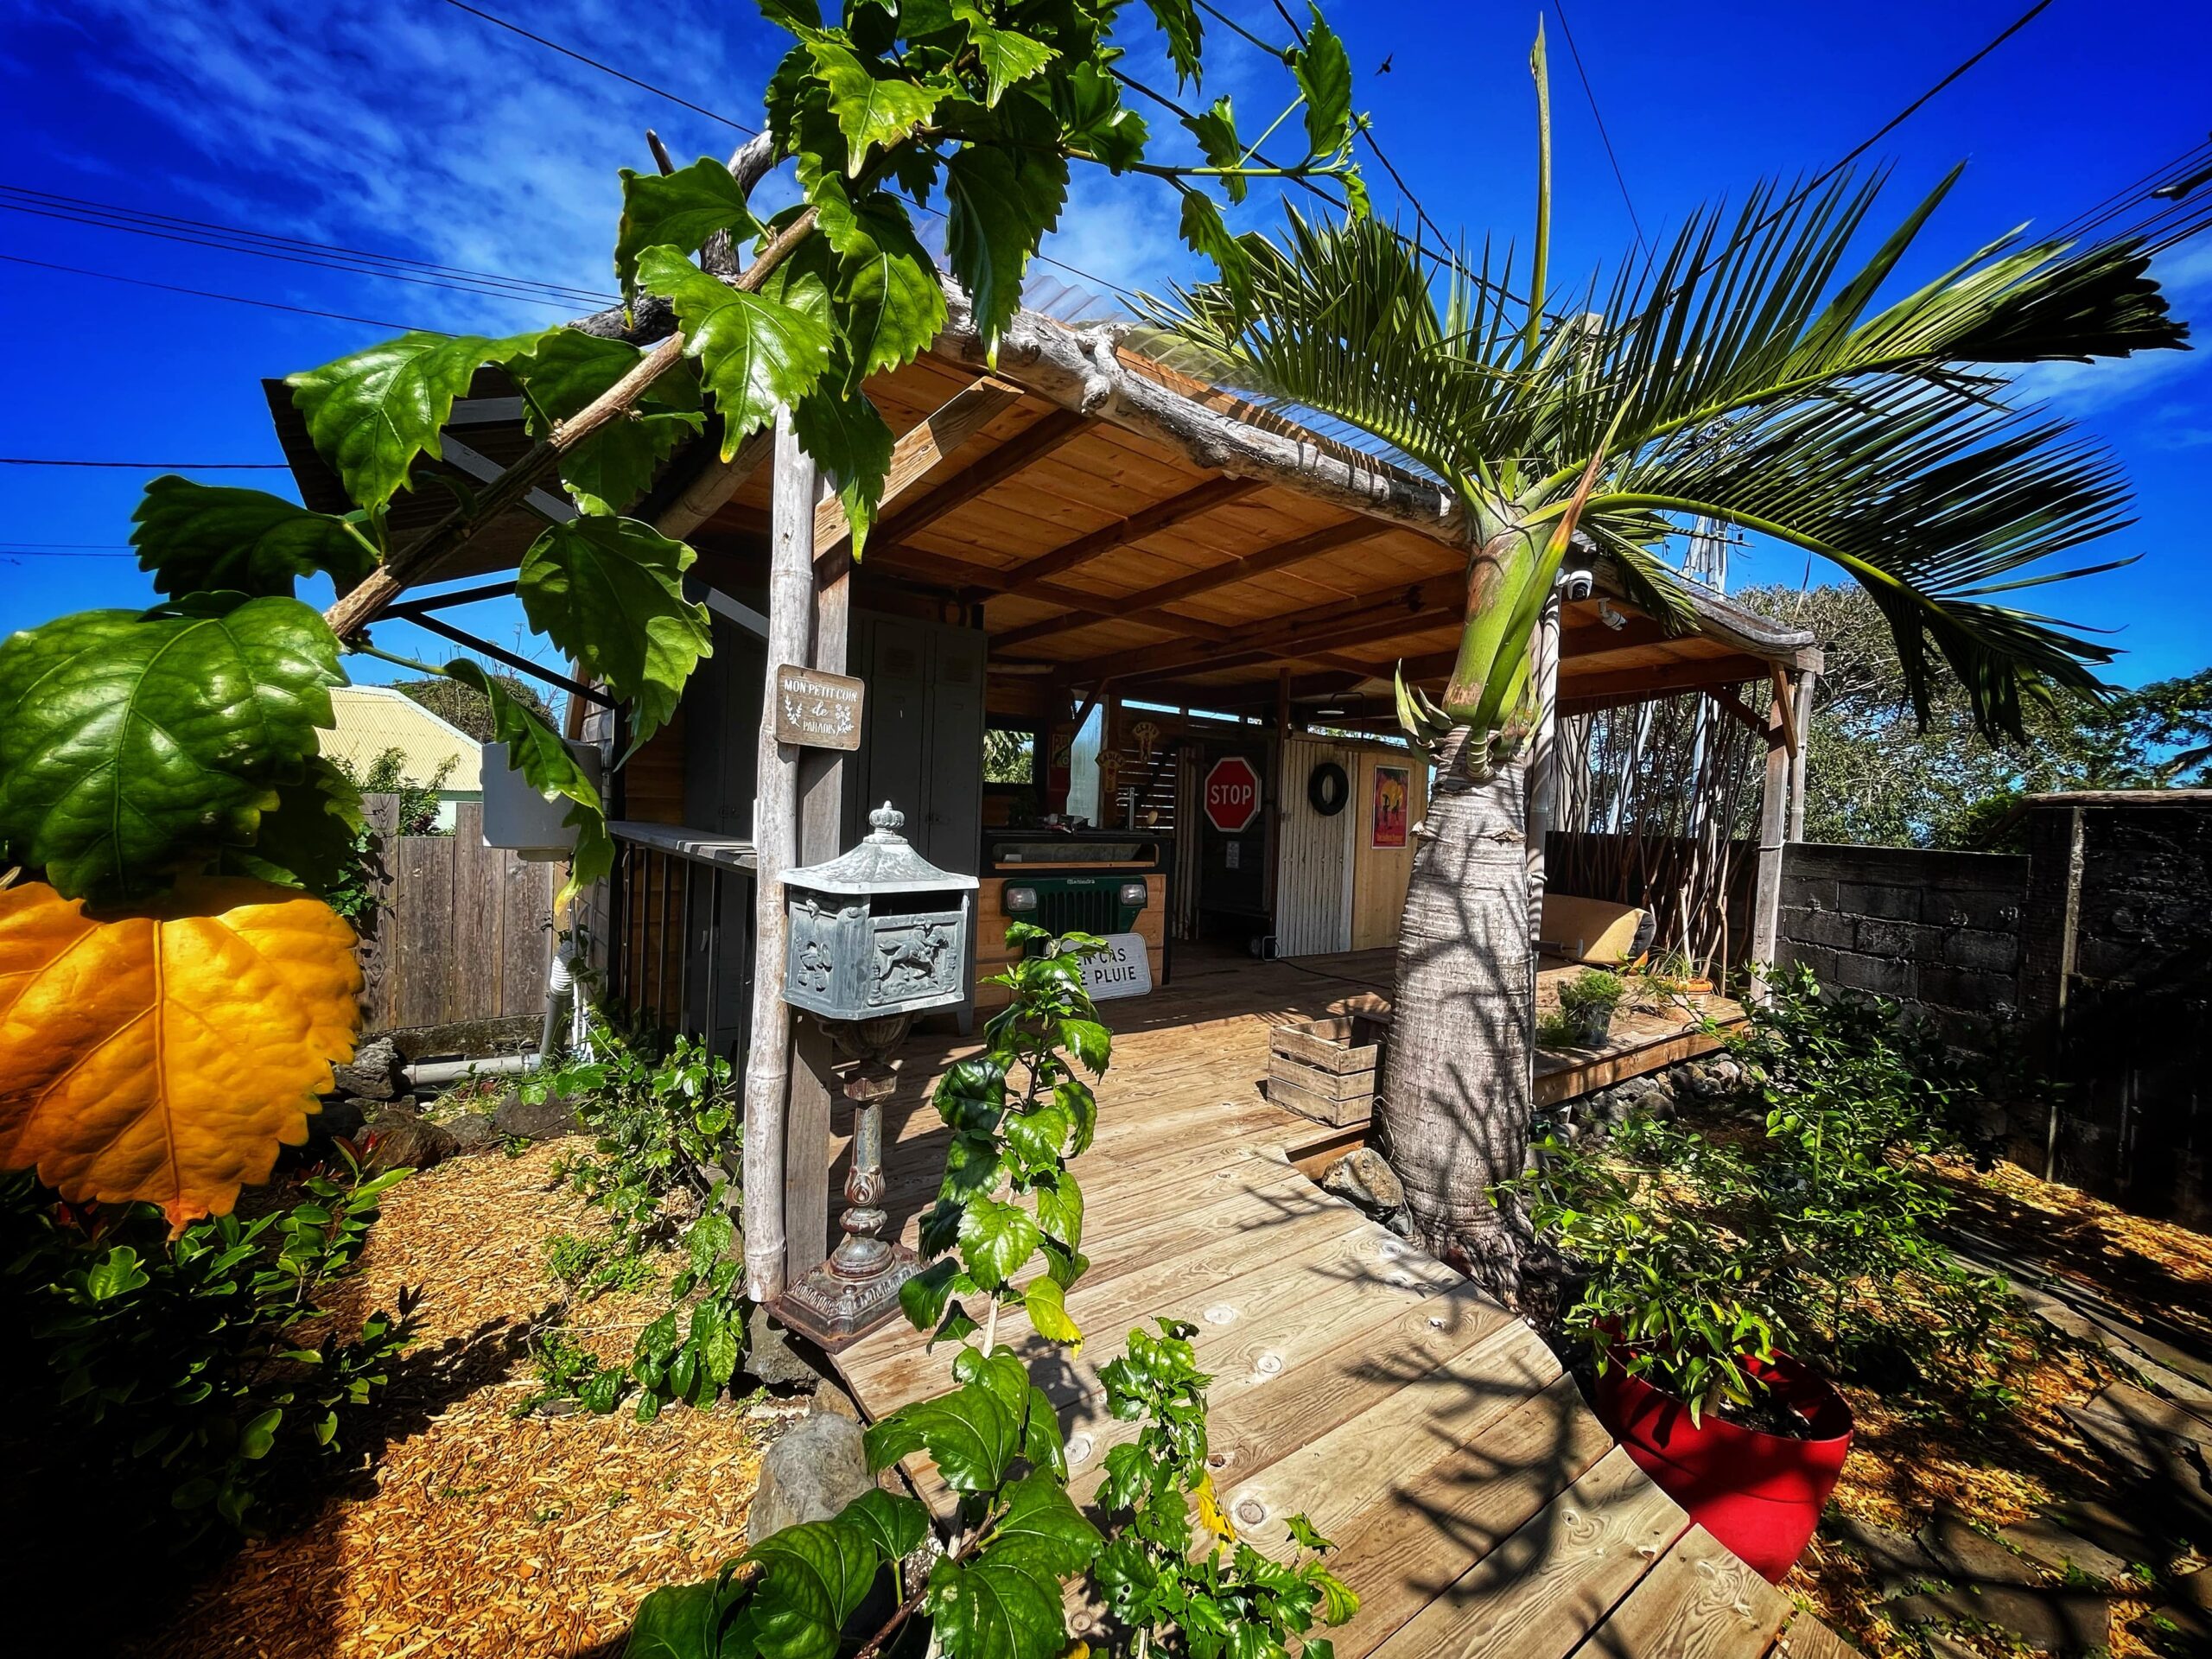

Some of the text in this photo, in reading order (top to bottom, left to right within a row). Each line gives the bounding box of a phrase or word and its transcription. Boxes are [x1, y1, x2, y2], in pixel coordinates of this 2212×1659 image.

[784, 679, 858, 702] MON PETIT COIN
[811, 701, 829, 716] de
[803, 720, 836, 734] PARADIS
[1211, 784, 1252, 805] STOP
[1099, 948, 1126, 963] CAS
[1094, 966, 1136, 984] PLUIE
